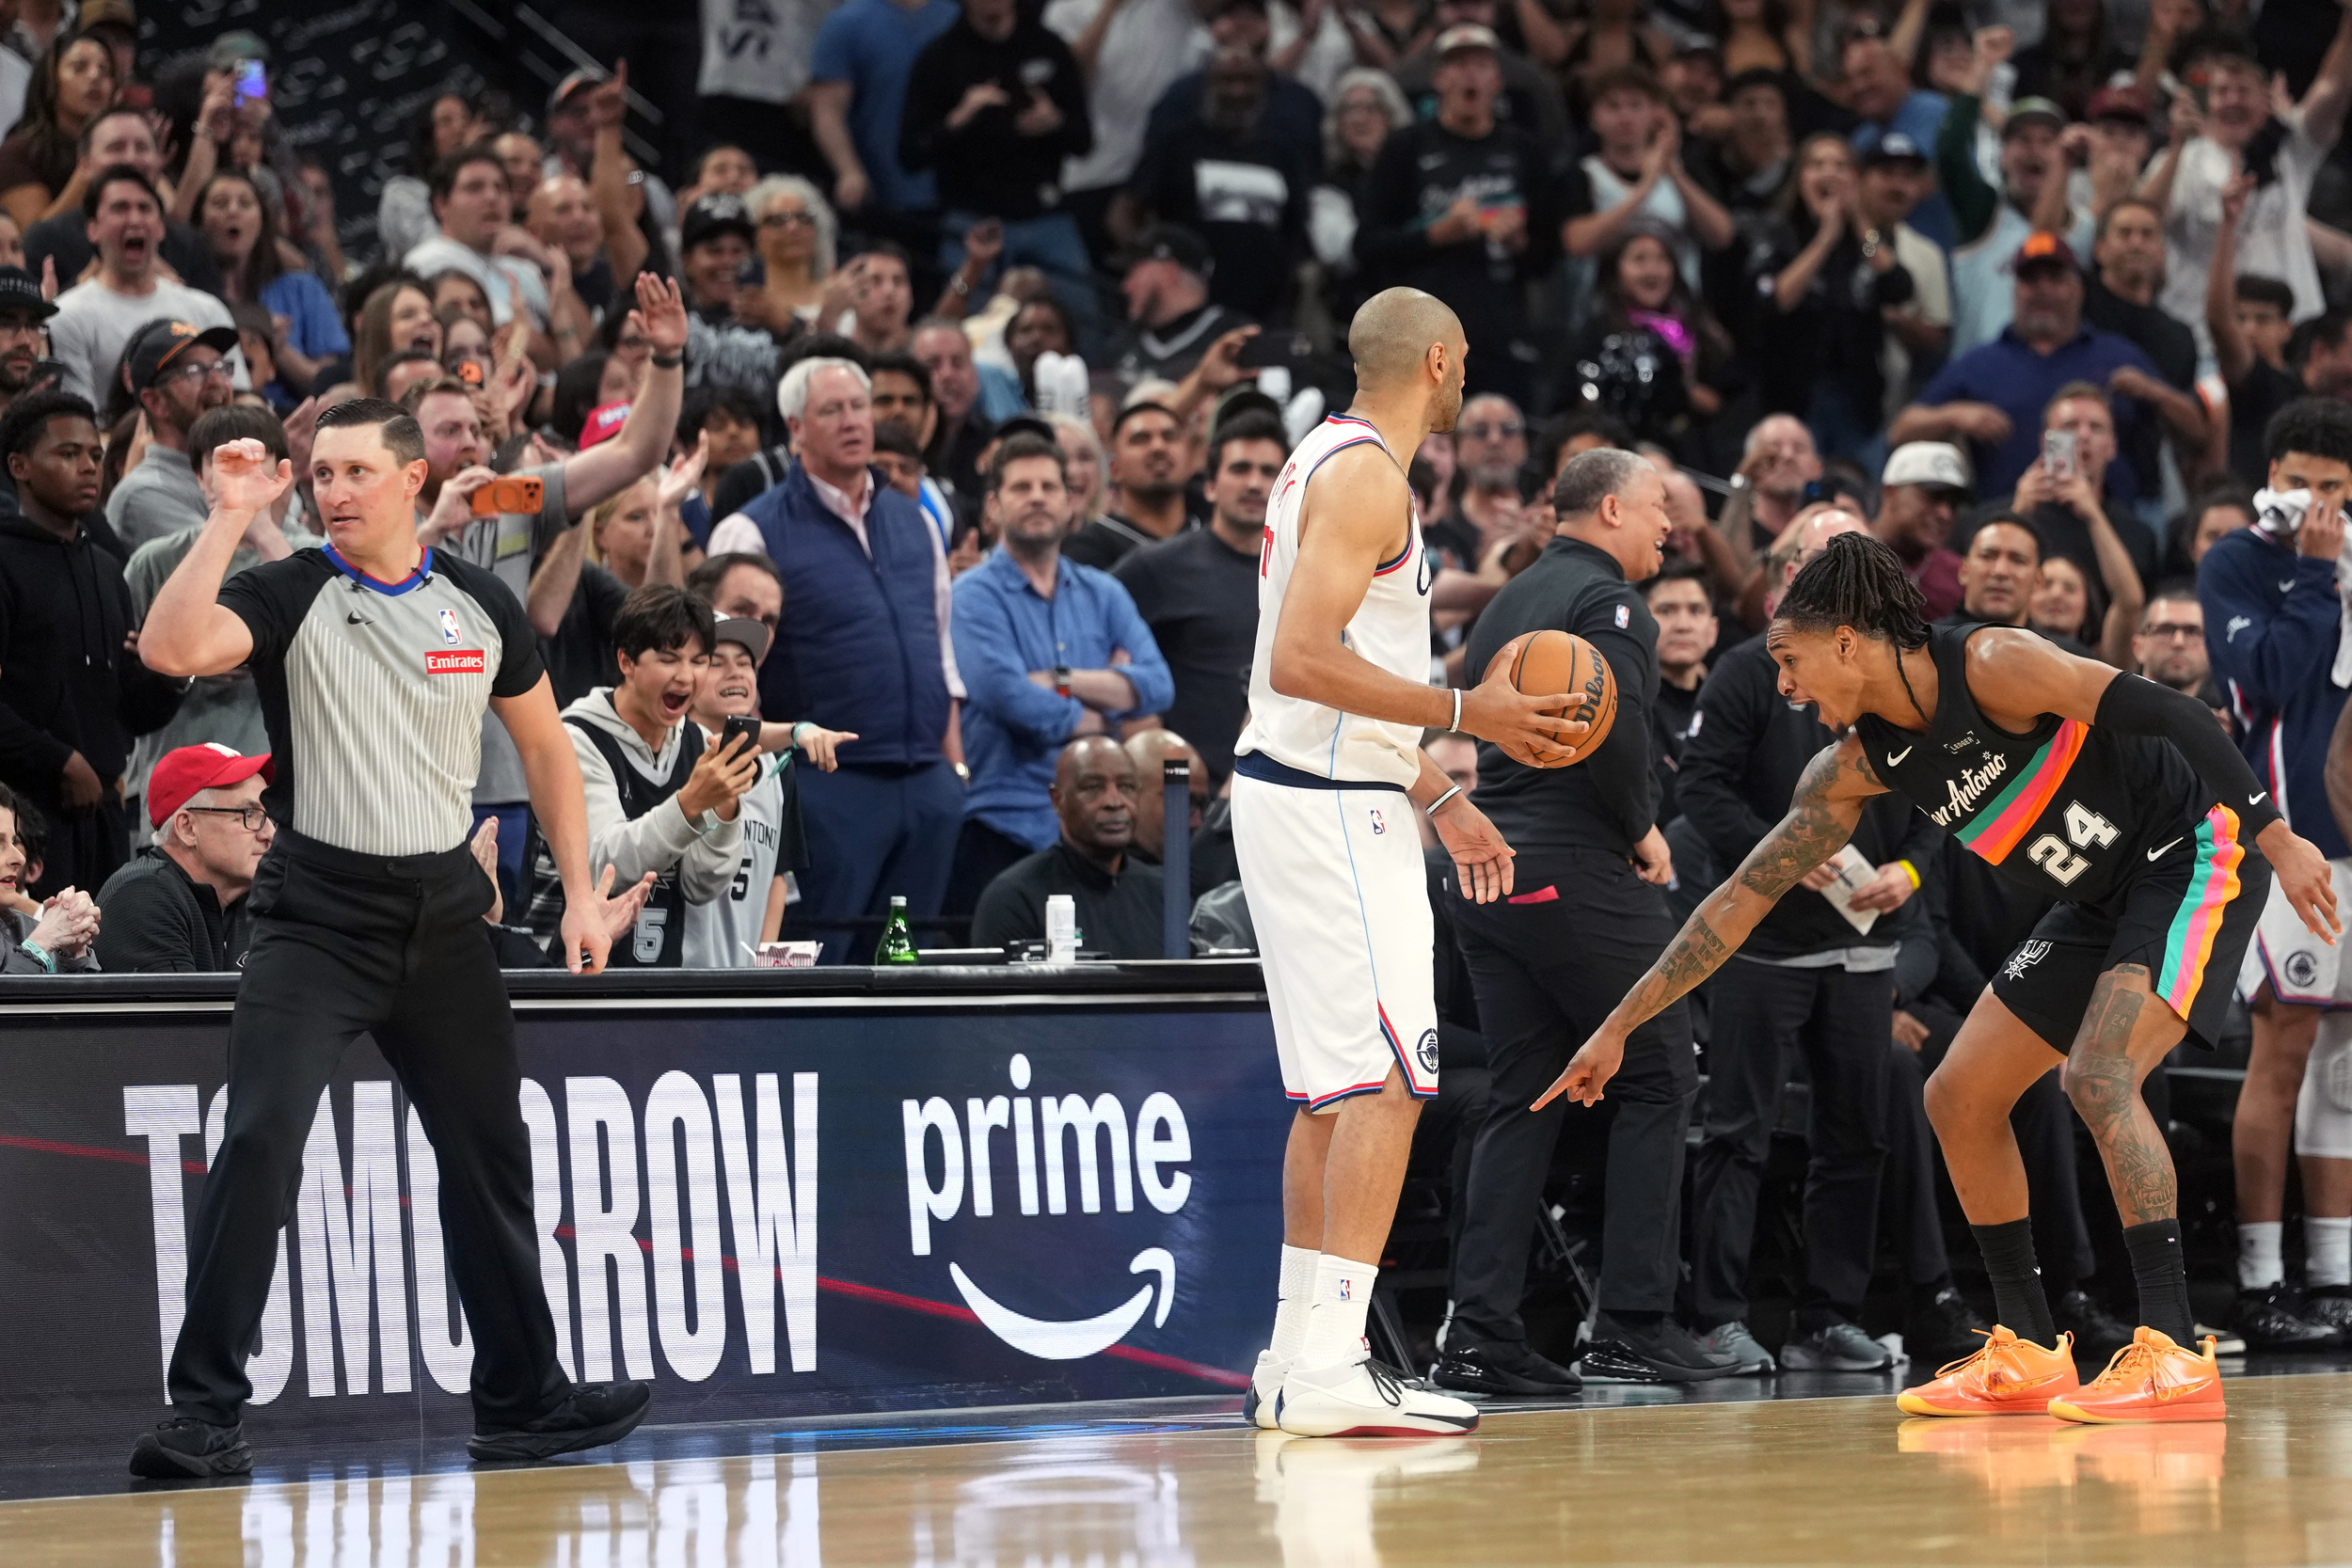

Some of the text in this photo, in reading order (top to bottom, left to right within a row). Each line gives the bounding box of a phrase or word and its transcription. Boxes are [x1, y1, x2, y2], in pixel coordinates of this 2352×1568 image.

[426, 655, 484, 669] Emirates
[1574, 648, 1604, 729] Wilson
[1949, 736, 1975, 751] LEDGER
[1947, 752, 2007, 817] Antonio
[2027, 800, 2122, 887] 24
[730, 859, 753, 901] 5
[632, 908, 668, 963] 5
[1692, 914, 1726, 953] TRUST
[1697, 942, 1713, 962] IN
[1684, 952, 1708, 976] HIM
[2111, 1014, 2127, 1027] 24
[123, 1053, 1192, 1405] TMROW prime
